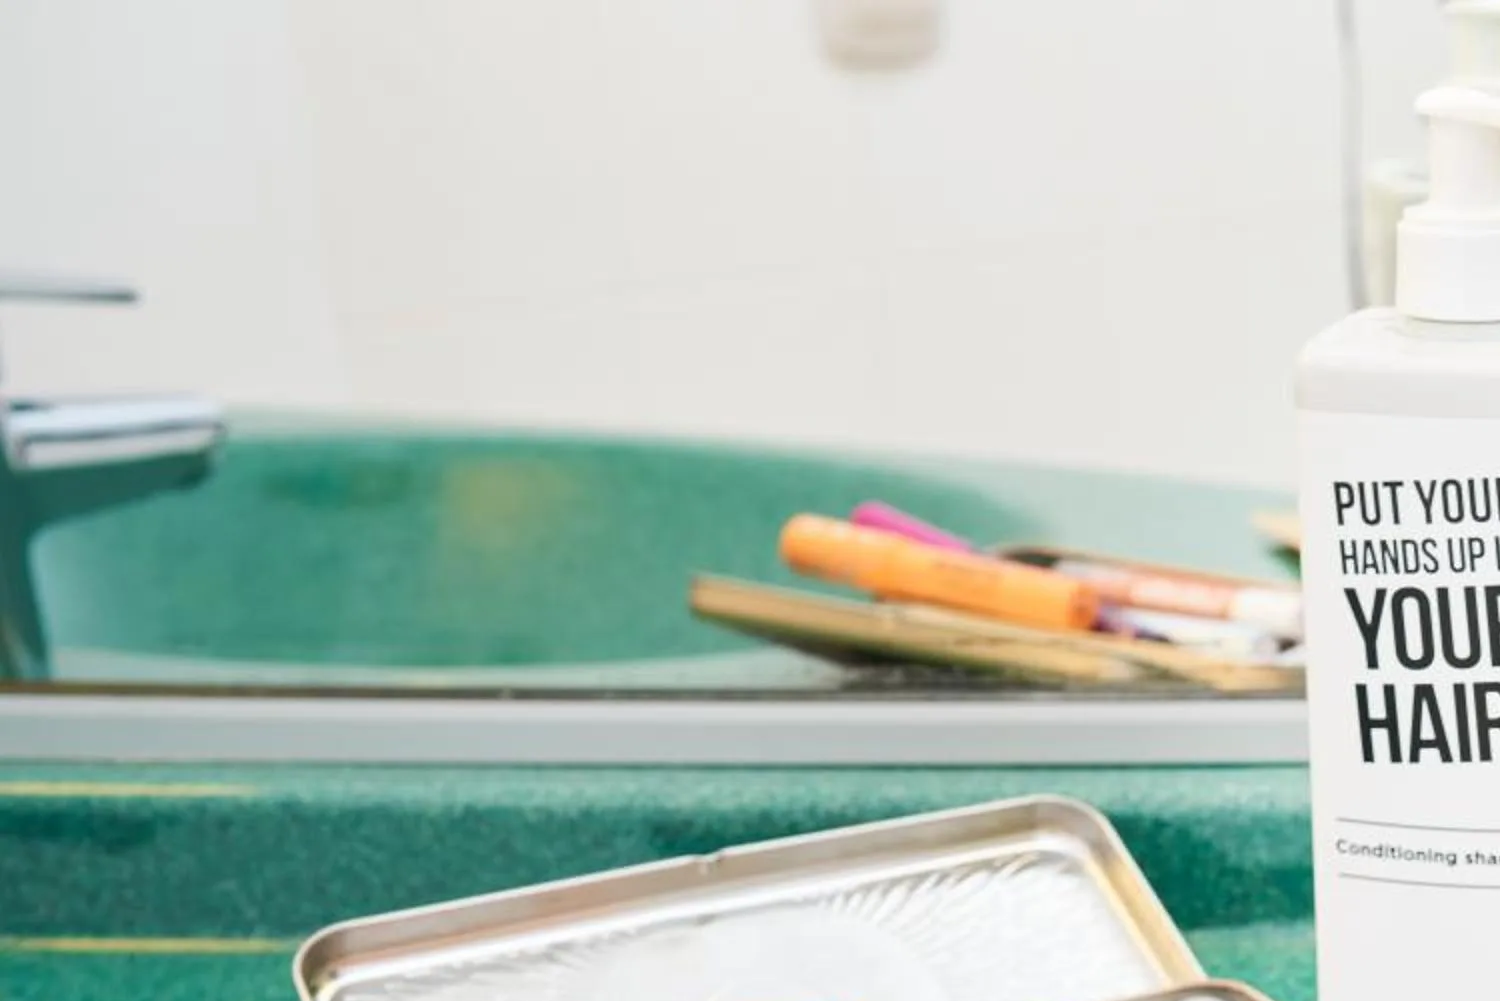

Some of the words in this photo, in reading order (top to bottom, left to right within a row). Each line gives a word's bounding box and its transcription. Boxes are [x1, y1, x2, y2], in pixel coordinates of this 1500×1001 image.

[1333, 480, 1404, 526] PUT
[1339, 538, 1439, 574] HANDS
[1447, 537, 1486, 573] UP
[1336, 839, 1457, 866] Conditioning
